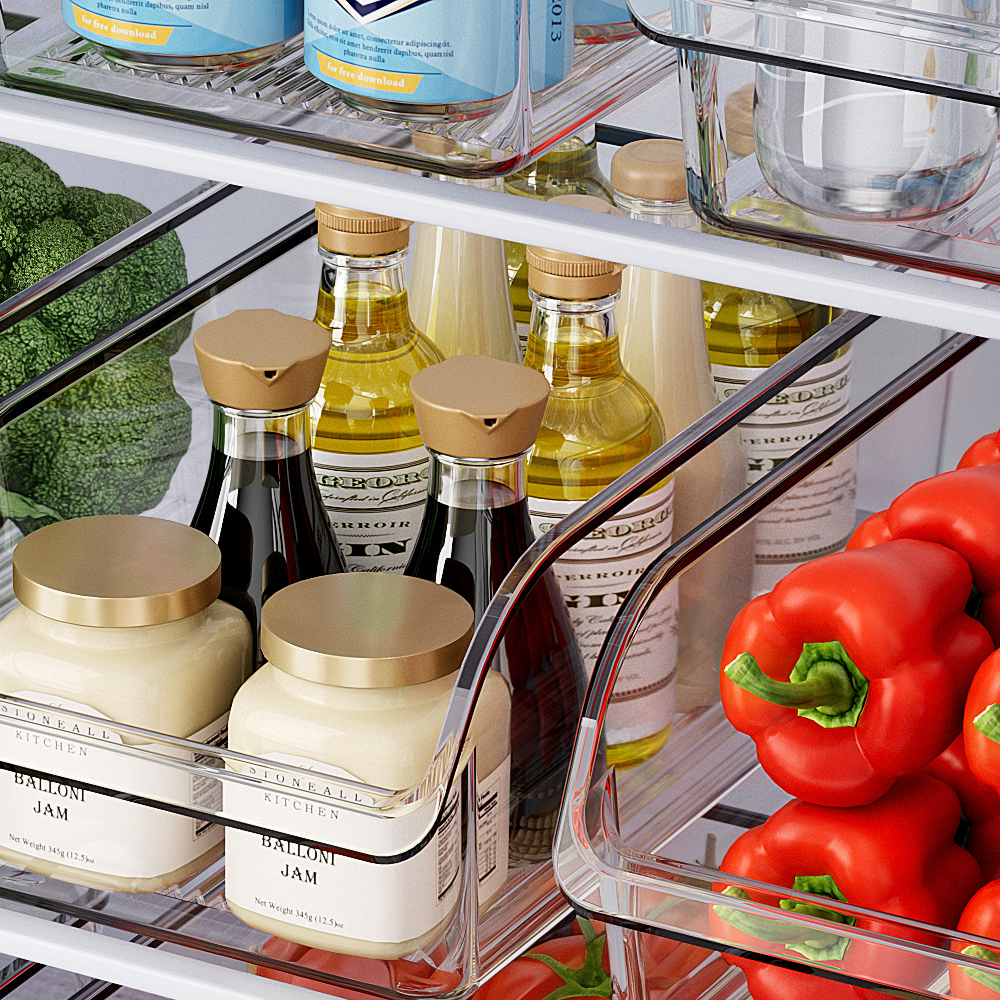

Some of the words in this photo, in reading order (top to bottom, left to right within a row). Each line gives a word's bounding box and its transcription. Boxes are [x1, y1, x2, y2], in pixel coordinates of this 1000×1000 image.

[97, 2, 120, 13] pharetra
[121, 7, 137, 16] nulla
[175, 3, 194, 11] quam
[82, 14, 92, 26] for
[93, 19, 108, 31] free
[111, 26, 157, 39] download
[551, 0, 562, 42] 013
[347, 39, 361, 49] amet
[362, 43, 392, 55] hendrerit
[393, 47, 423, 58] dapibus,
[350, 31, 366, 41] amet,
[366, 35, 404, 46] consectetur
[405, 40, 441, 48] adipiscing
[343, 48, 368, 61] pharetra
[369, 55, 385, 63] nulla
[327, 62, 338, 74] for
[339, 66, 355, 79] free
[358, 72, 405, 87] download
[332, 521, 410, 529] ERROIR
[557, 567, 645, 581] ERROIR
[15, 729, 88, 757] KITCHEN
[33, 800, 69, 821] JAM
[263, 792, 340, 820] KITCHEN
[9, 833, 21, 844] Net
[22, 837, 46, 852] Weight
[48, 845, 65, 859] 345g
[280, 864, 318, 885] JAM
[254, 896, 267, 908] Net
[268, 901, 294, 916] Weight
[295, 909, 313, 923] 345g
